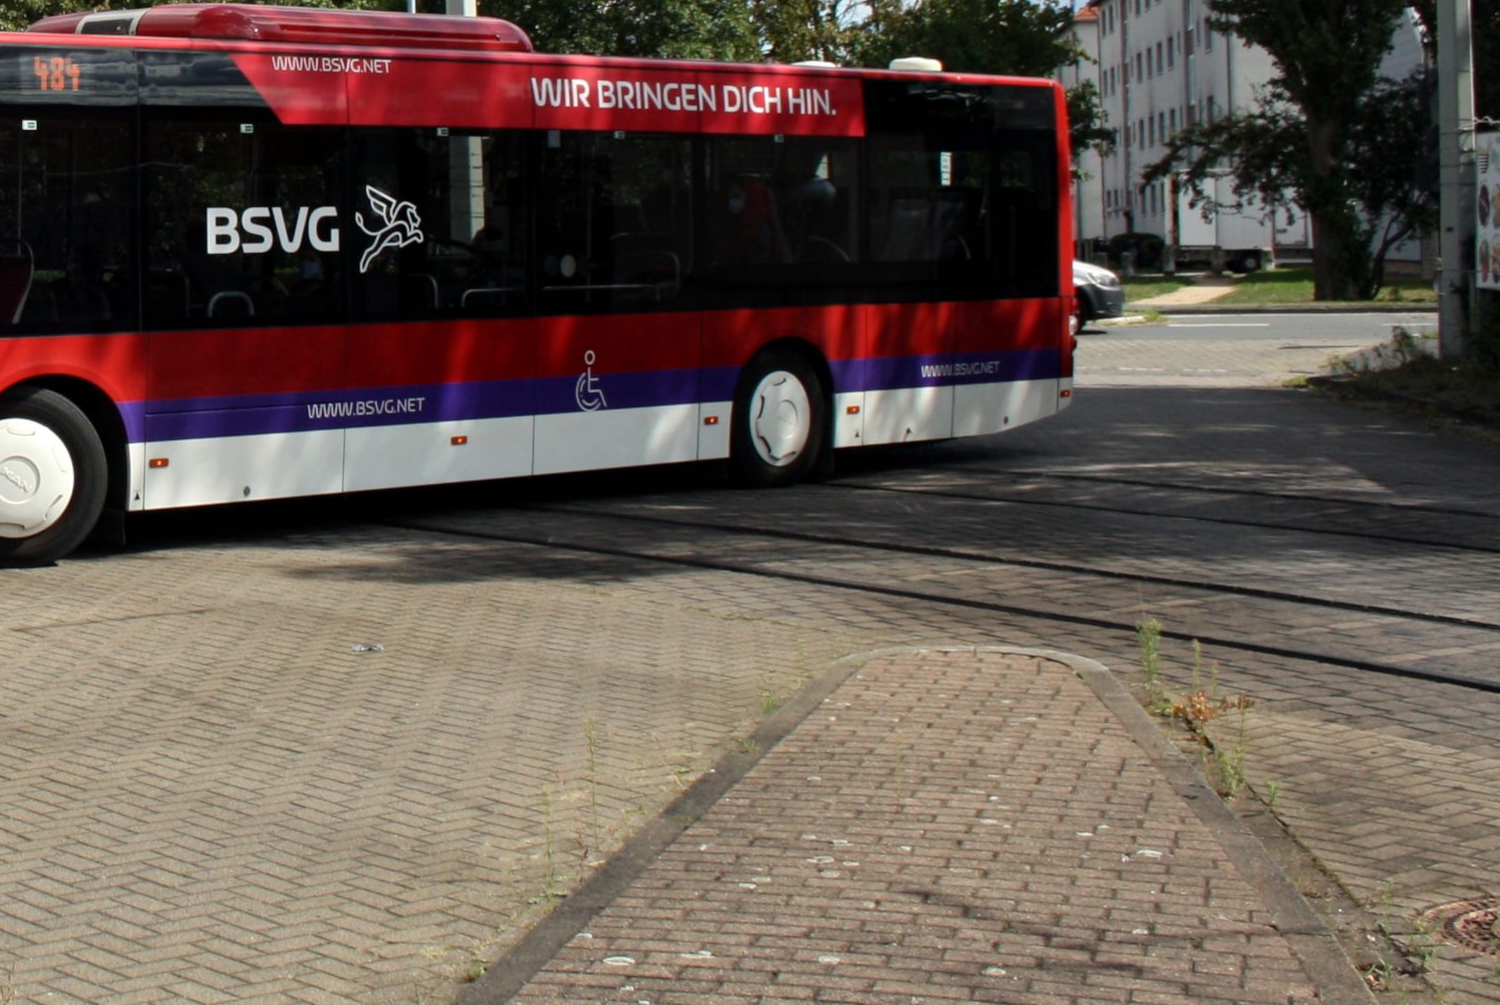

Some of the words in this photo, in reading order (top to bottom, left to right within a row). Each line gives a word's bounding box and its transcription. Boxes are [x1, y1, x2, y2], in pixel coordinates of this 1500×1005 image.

[34, 56, 81, 91] 484
[271, 55, 392, 74] WWW.BSVG.NET
[531, 77, 590, 108] WIR
[597, 79, 717, 113] BRINGEN
[723, 84, 781, 114] DICH
[788, 87, 837, 116] HIN.
[206, 206, 340, 255] BSVG
[920, 360, 1001, 378] WWW.BSVG.NET
[307, 397, 426, 419] WWW.BSVG.NET
